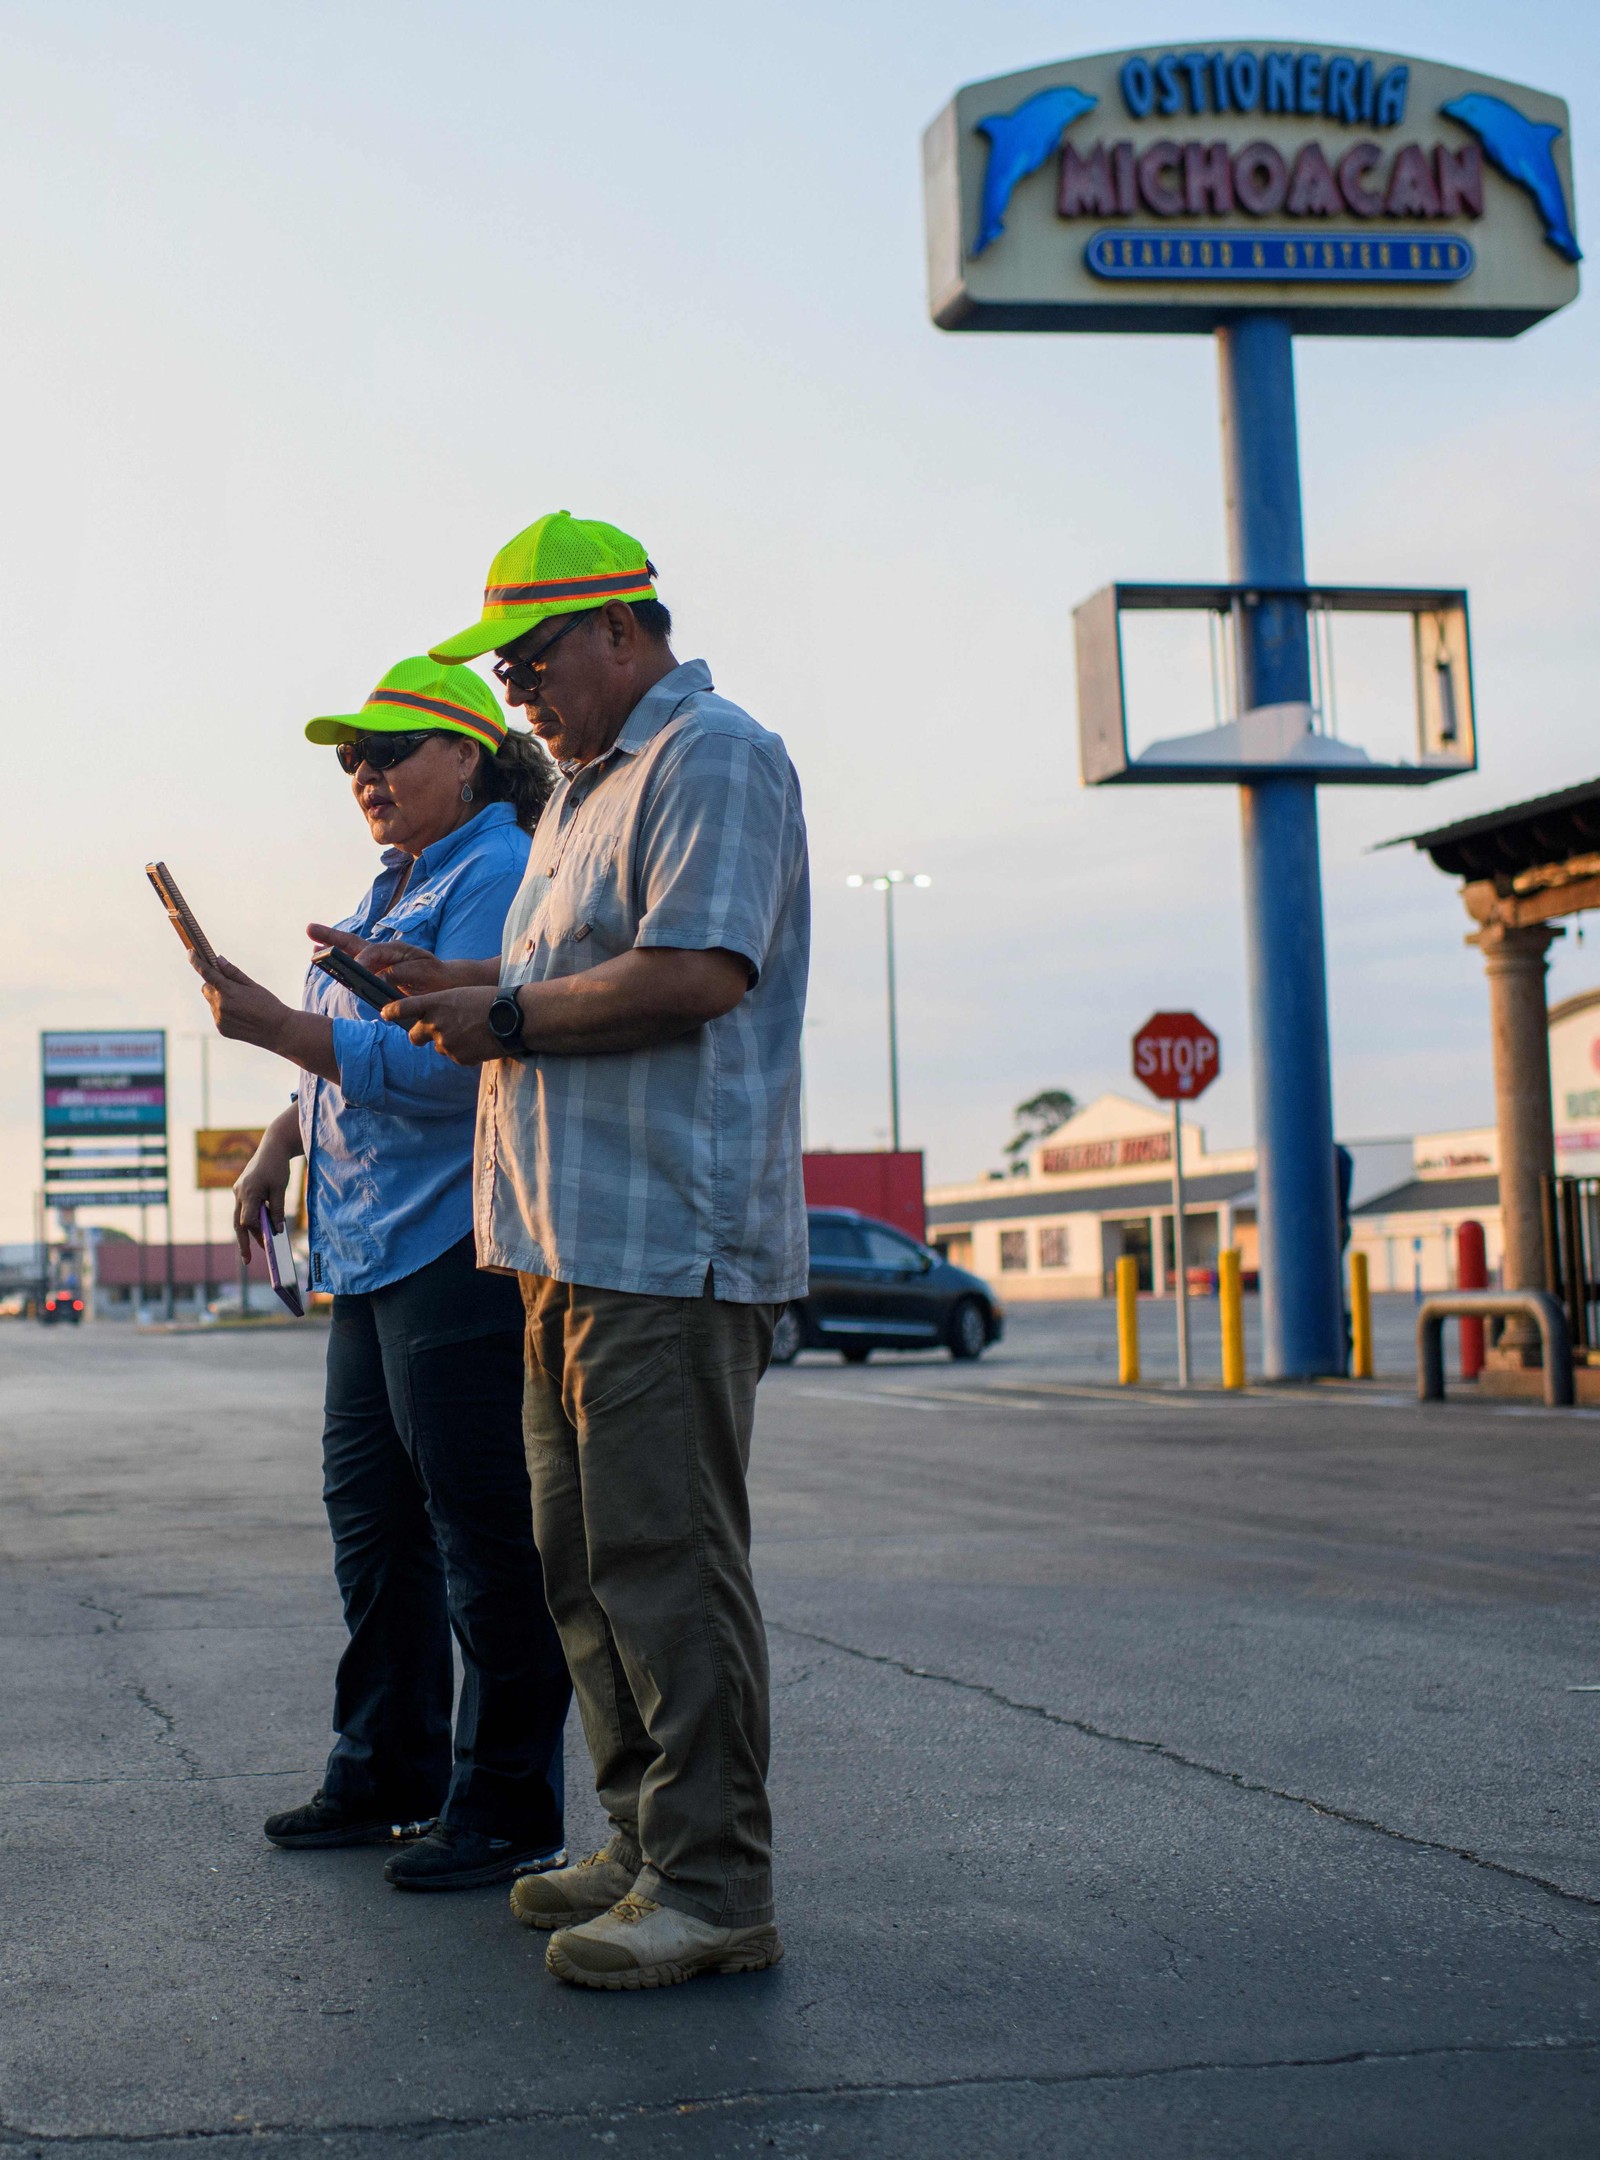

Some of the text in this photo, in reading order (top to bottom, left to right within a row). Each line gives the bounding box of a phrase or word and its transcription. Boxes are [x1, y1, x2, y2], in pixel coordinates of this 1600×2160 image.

[1120, 51, 1409, 126] OSTIONERIA
[1057, 141, 1485, 217] MICHOACAN
[1102, 239, 1233, 268] SEAFOOD
[1284, 242, 1391, 270] OYSTER
[1409, 243, 1461, 270] BAR
[1137, 1036, 1215, 1076] STOP
